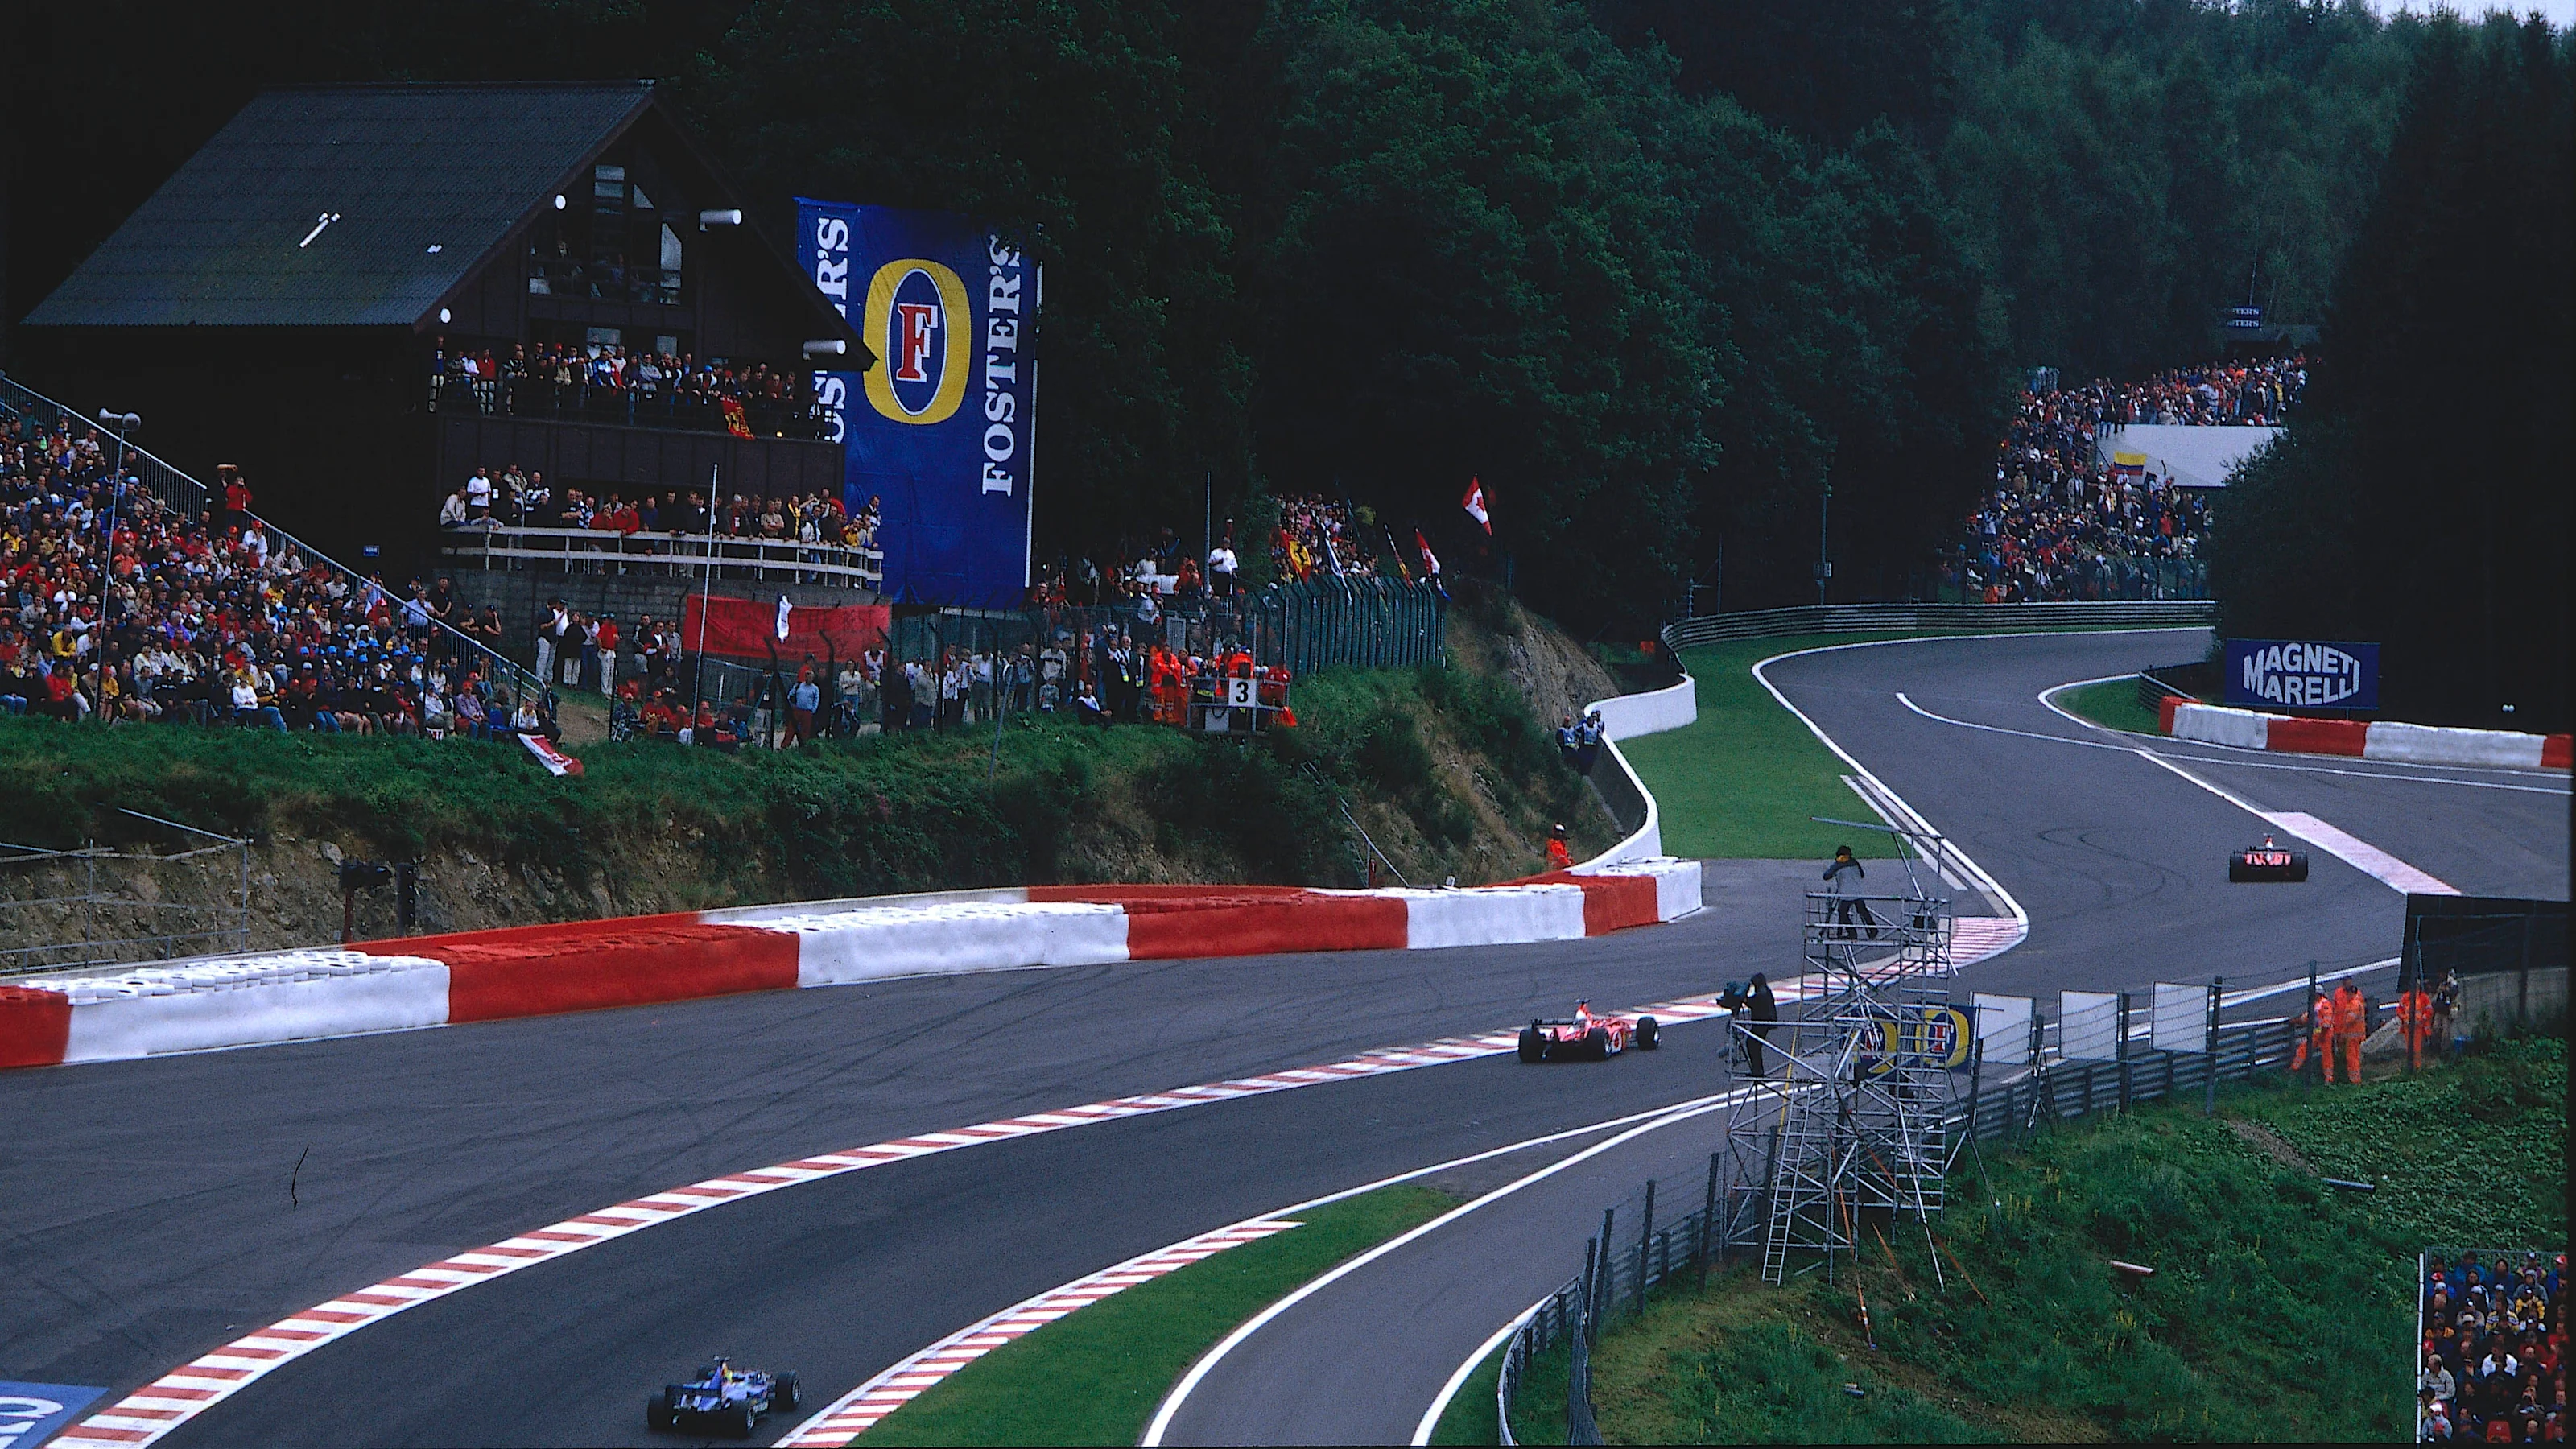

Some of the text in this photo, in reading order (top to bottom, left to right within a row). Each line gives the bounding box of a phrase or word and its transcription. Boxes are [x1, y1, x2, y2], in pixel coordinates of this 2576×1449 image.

[896, 303, 938, 382] F
[981, 233, 1021, 497] FOSTER'S
[1236, 681, 1249, 703] 3
[2243, 642, 2360, 692] MAGNETI
[2243, 656, 2360, 706] MARELLI
